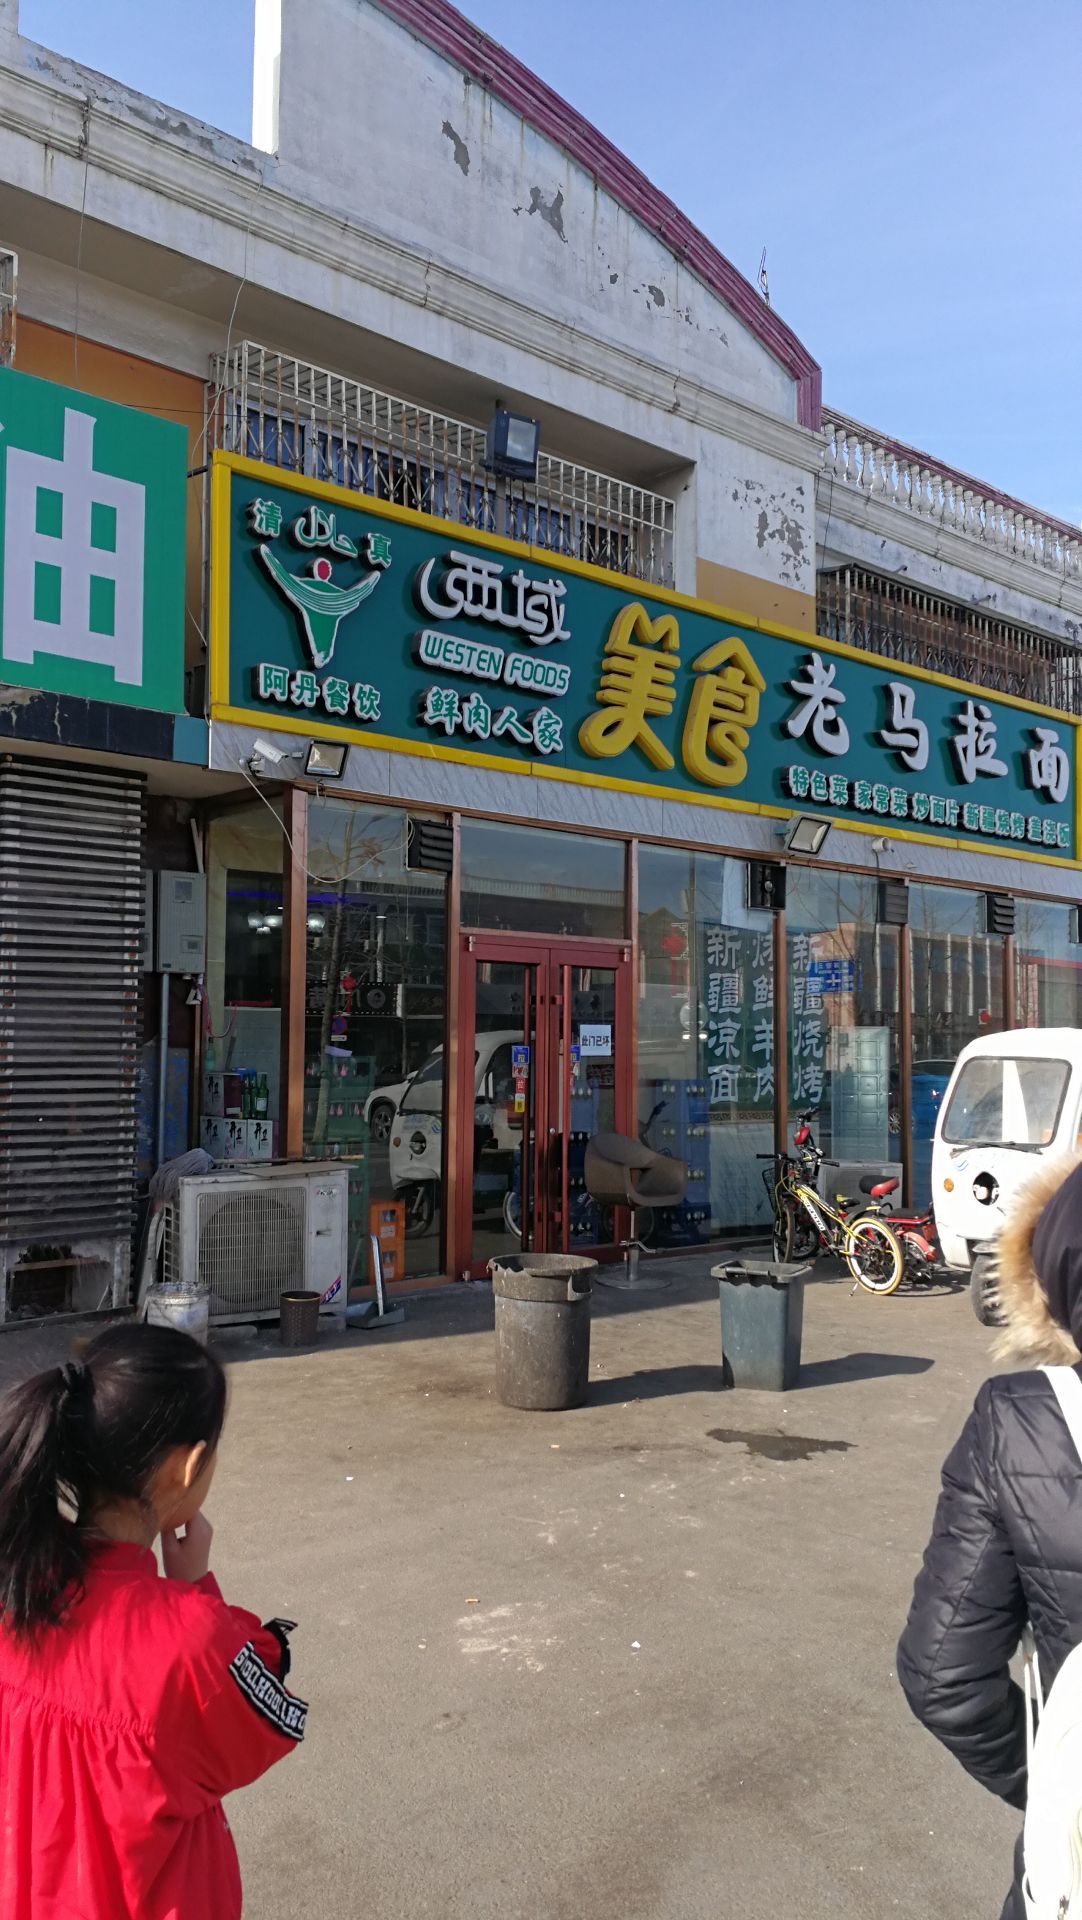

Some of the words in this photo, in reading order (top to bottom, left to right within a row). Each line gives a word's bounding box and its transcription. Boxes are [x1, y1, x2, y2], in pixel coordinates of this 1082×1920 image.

[253, 498, 283, 538] 清
[295, 506, 358, 558] حلال
[368, 532, 392, 568] 真
[420, 550, 571, 645] 西域
[259, 663, 381, 722] 阿丹餐饮
[421, 631, 503, 679] WESTEN
[505, 654, 570, 695] FOODS
[578, 602, 766, 787] 美食
[423, 686, 564, 755] 鲜肉人家
[786, 652, 1069, 804] 老马拉面
[789, 765, 849, 805] 特色菜
[854, 780, 908, 817] 家常菜
[706, 926, 742, 1104] 新疆凉面
[792, 932, 824, 1103] 新疆烧烤
